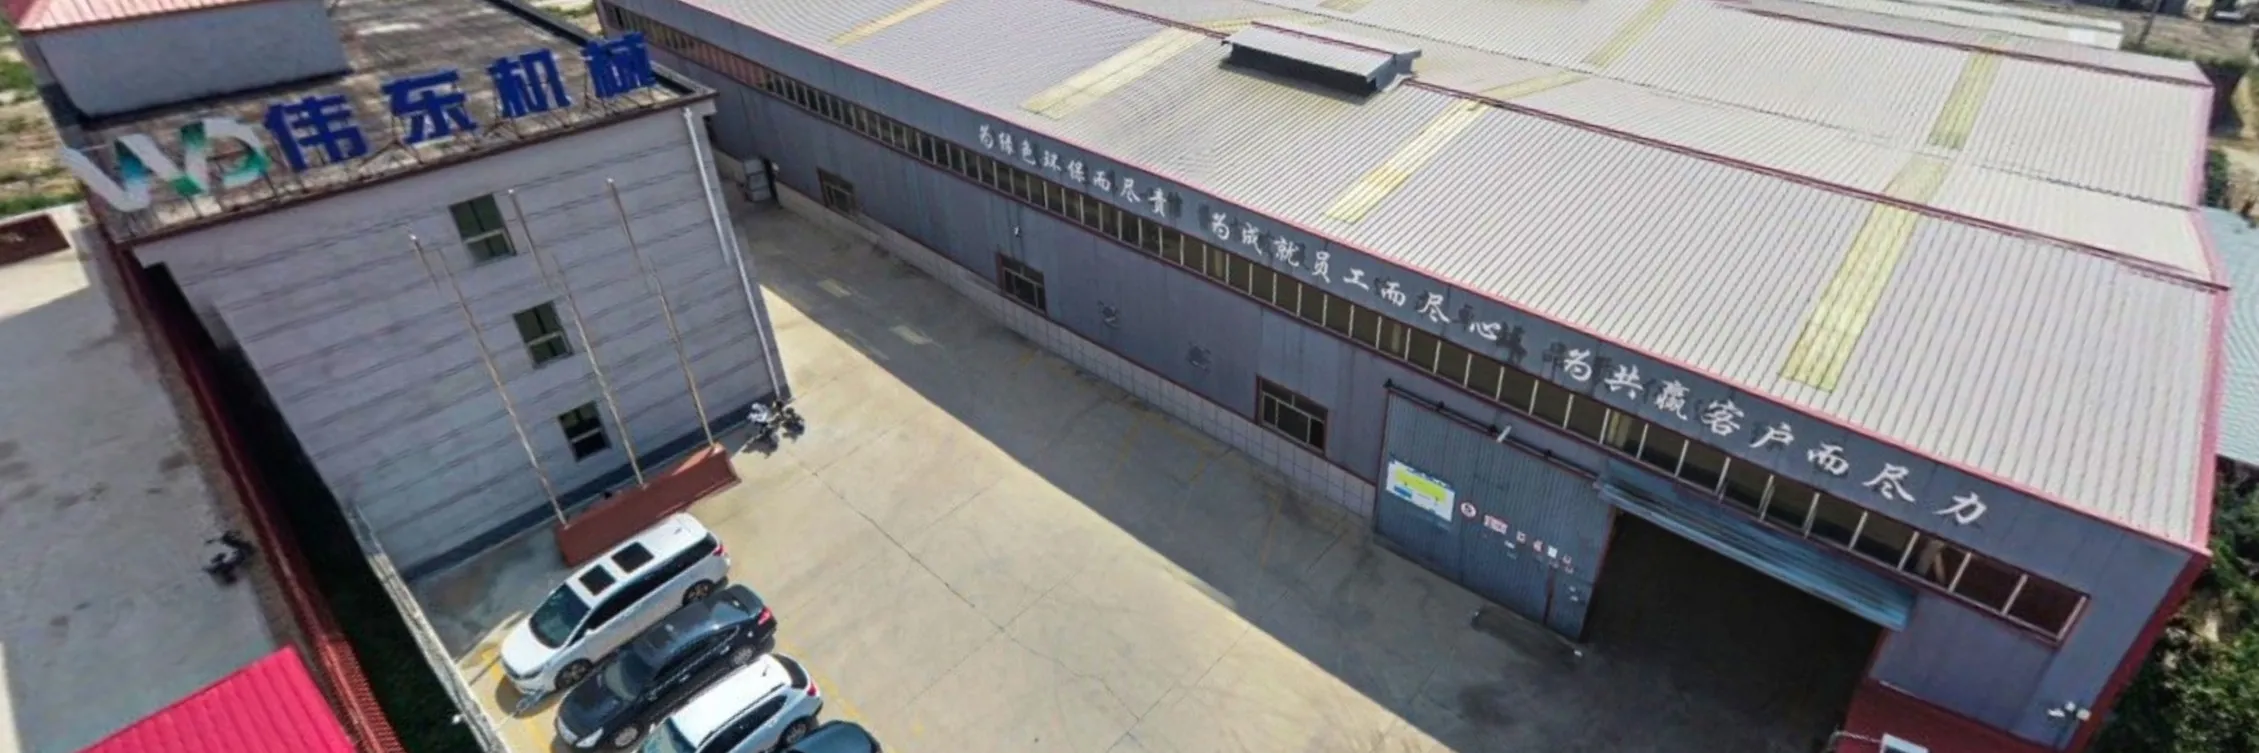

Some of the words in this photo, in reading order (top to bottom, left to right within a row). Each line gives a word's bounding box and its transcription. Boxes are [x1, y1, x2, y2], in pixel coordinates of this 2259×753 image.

[264, 32, 656, 170] 伟东机械
[1211, 212, 1502, 341] 为成就员工而尽心
[1564, 347, 1988, 525] 为共赢客户而尽力
